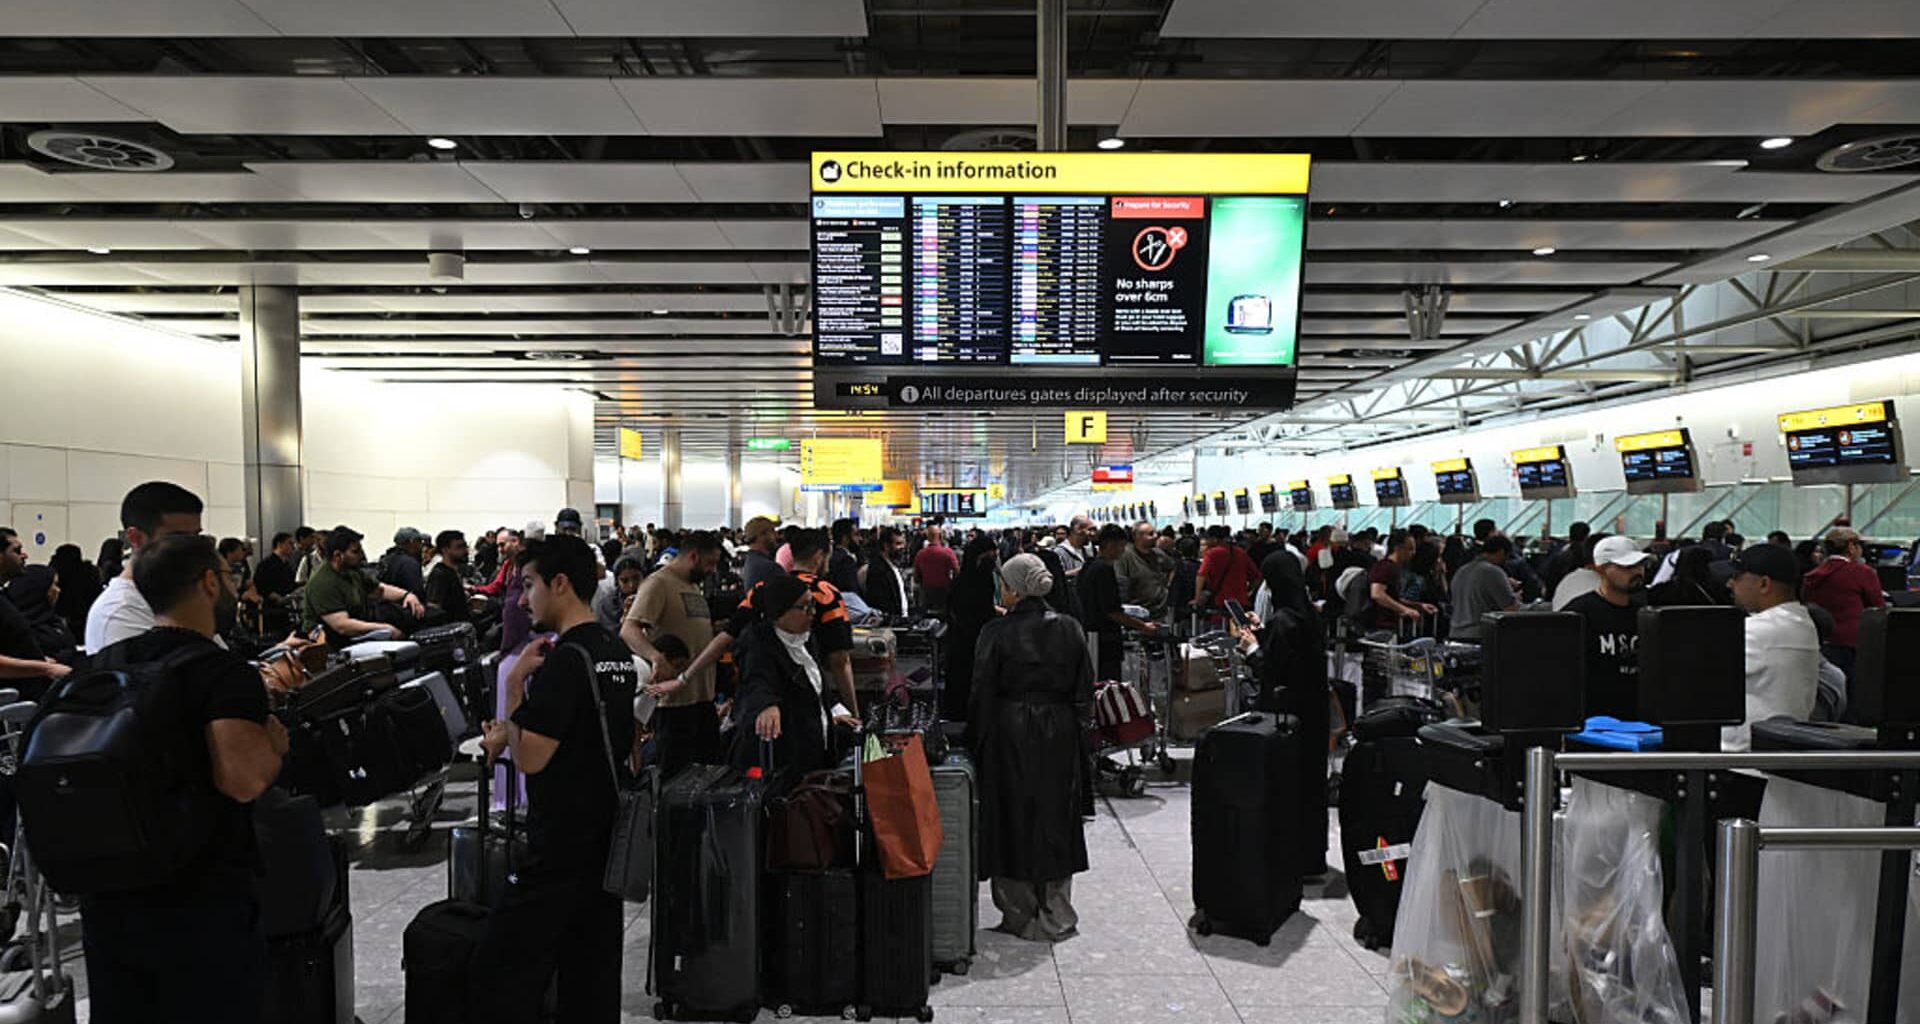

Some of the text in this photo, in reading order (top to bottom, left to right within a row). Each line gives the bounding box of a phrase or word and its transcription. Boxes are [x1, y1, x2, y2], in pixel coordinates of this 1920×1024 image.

[846, 161, 1057, 179] Check-in information
[1116, 278, 1175, 292] No sharps
[1115, 291, 1169, 302] over 6cm
[922, 386, 1248, 404] All departures gates displayed after security
[1082, 416, 1094, 438] F
